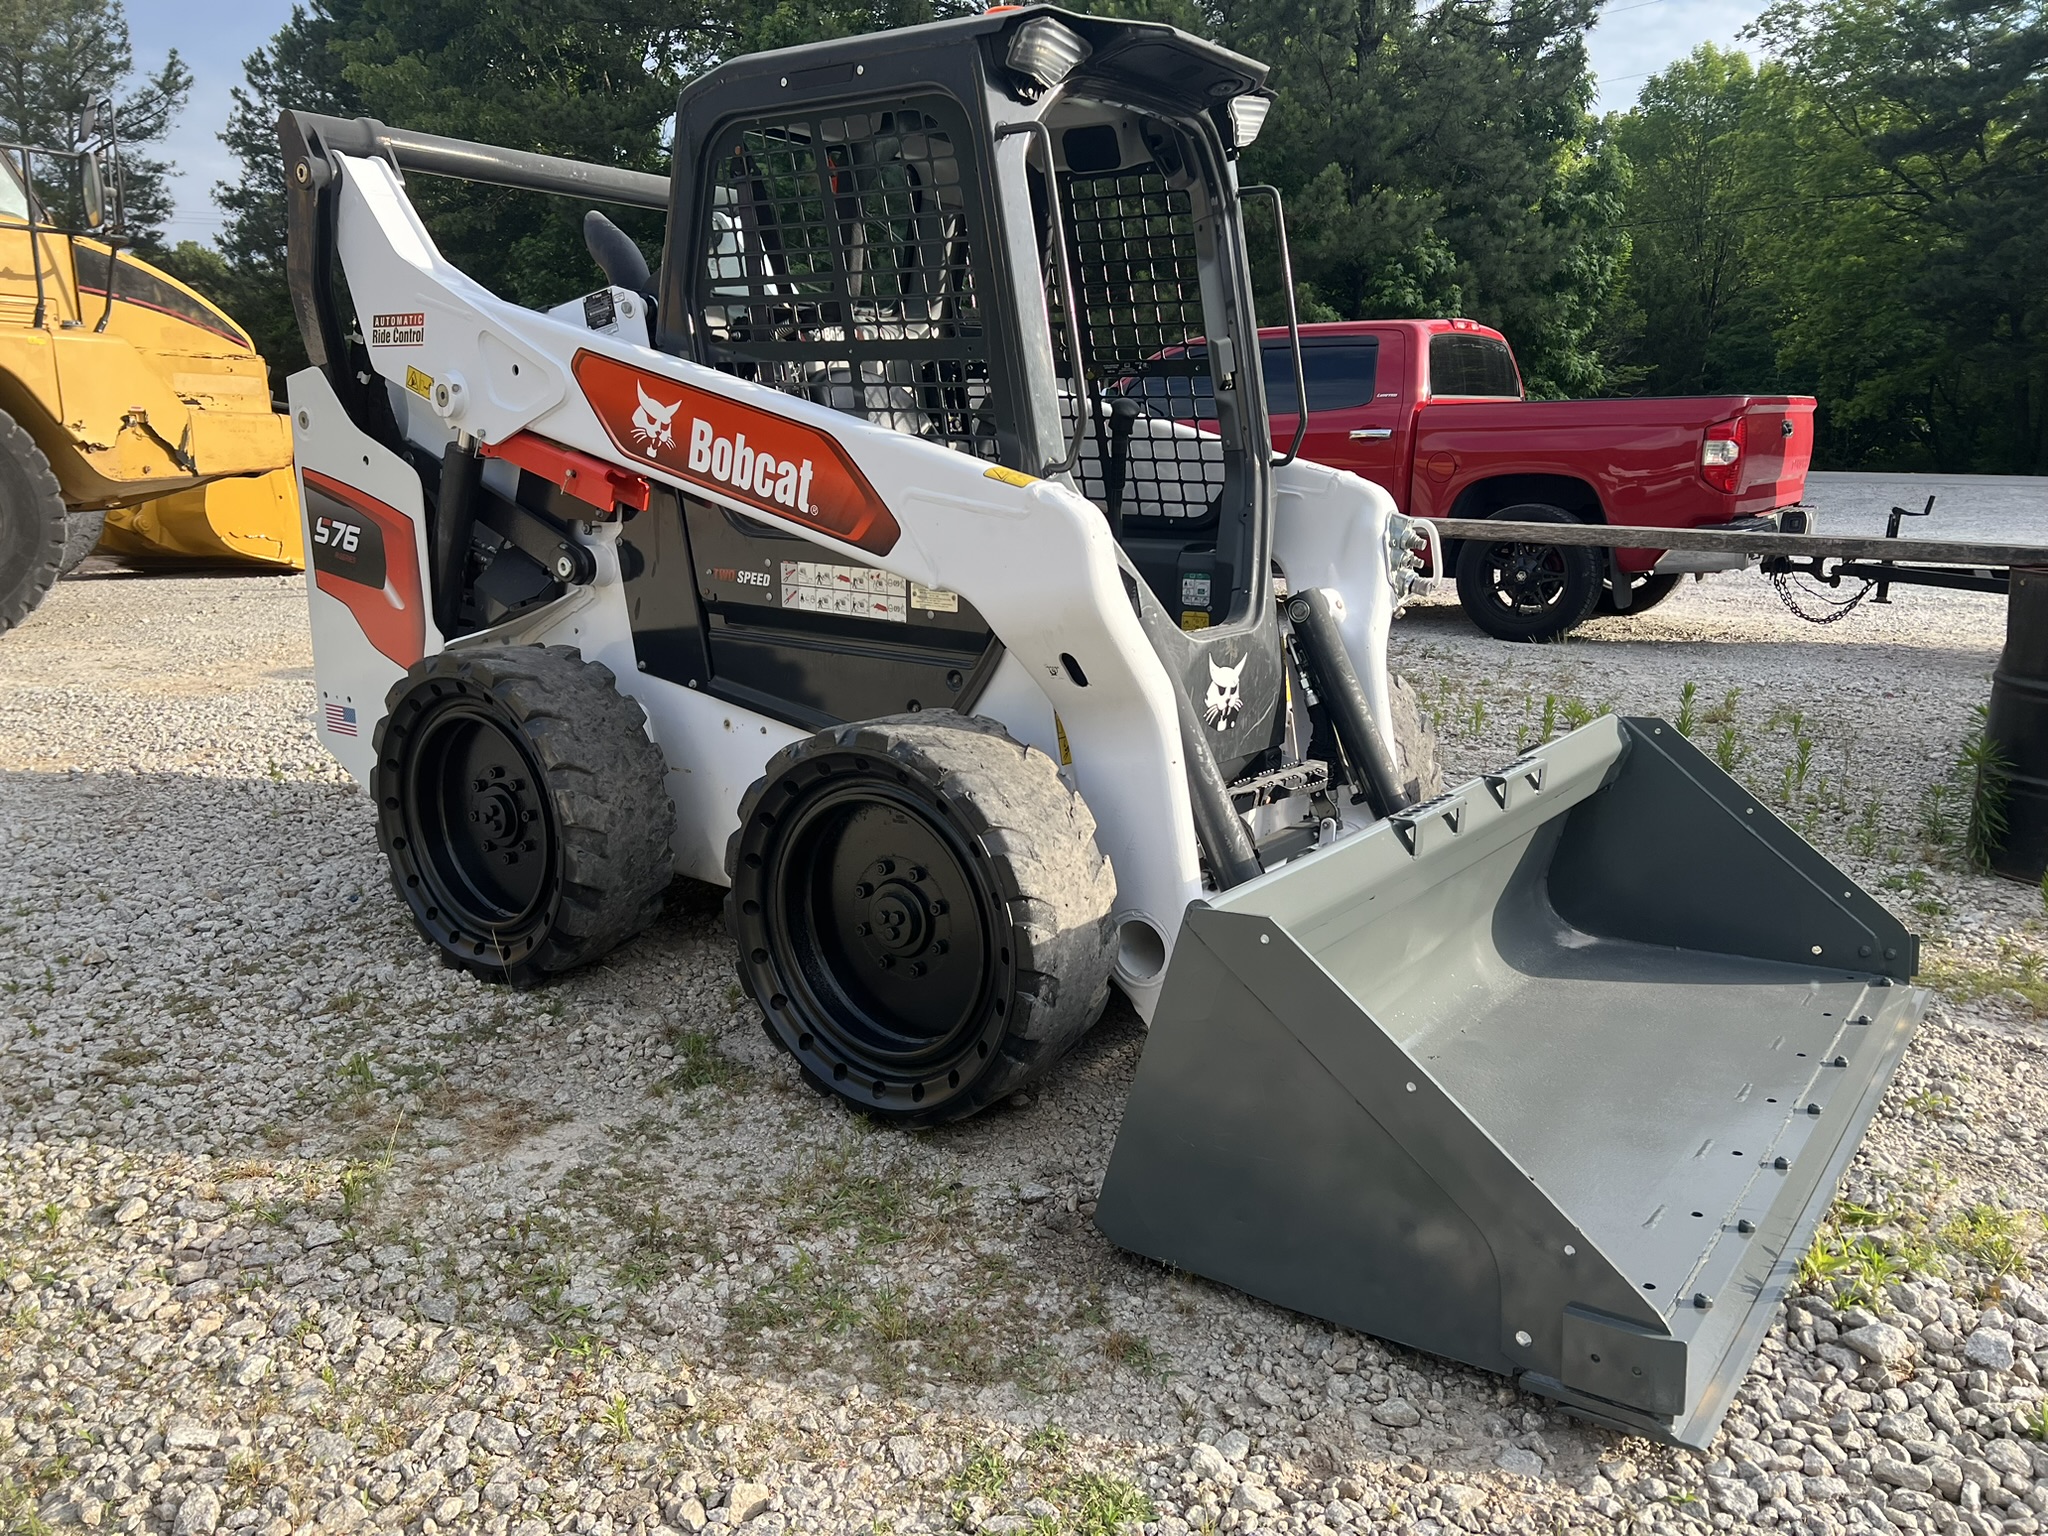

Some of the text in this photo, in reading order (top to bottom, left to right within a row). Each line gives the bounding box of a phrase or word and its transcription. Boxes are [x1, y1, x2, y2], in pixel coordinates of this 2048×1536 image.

[374, 314, 423, 326] AUTOMATIC
[372, 328, 424, 344] Ride Control
[314, 516, 361, 553] S76
[713, 567, 771, 587] TWO SPEED
